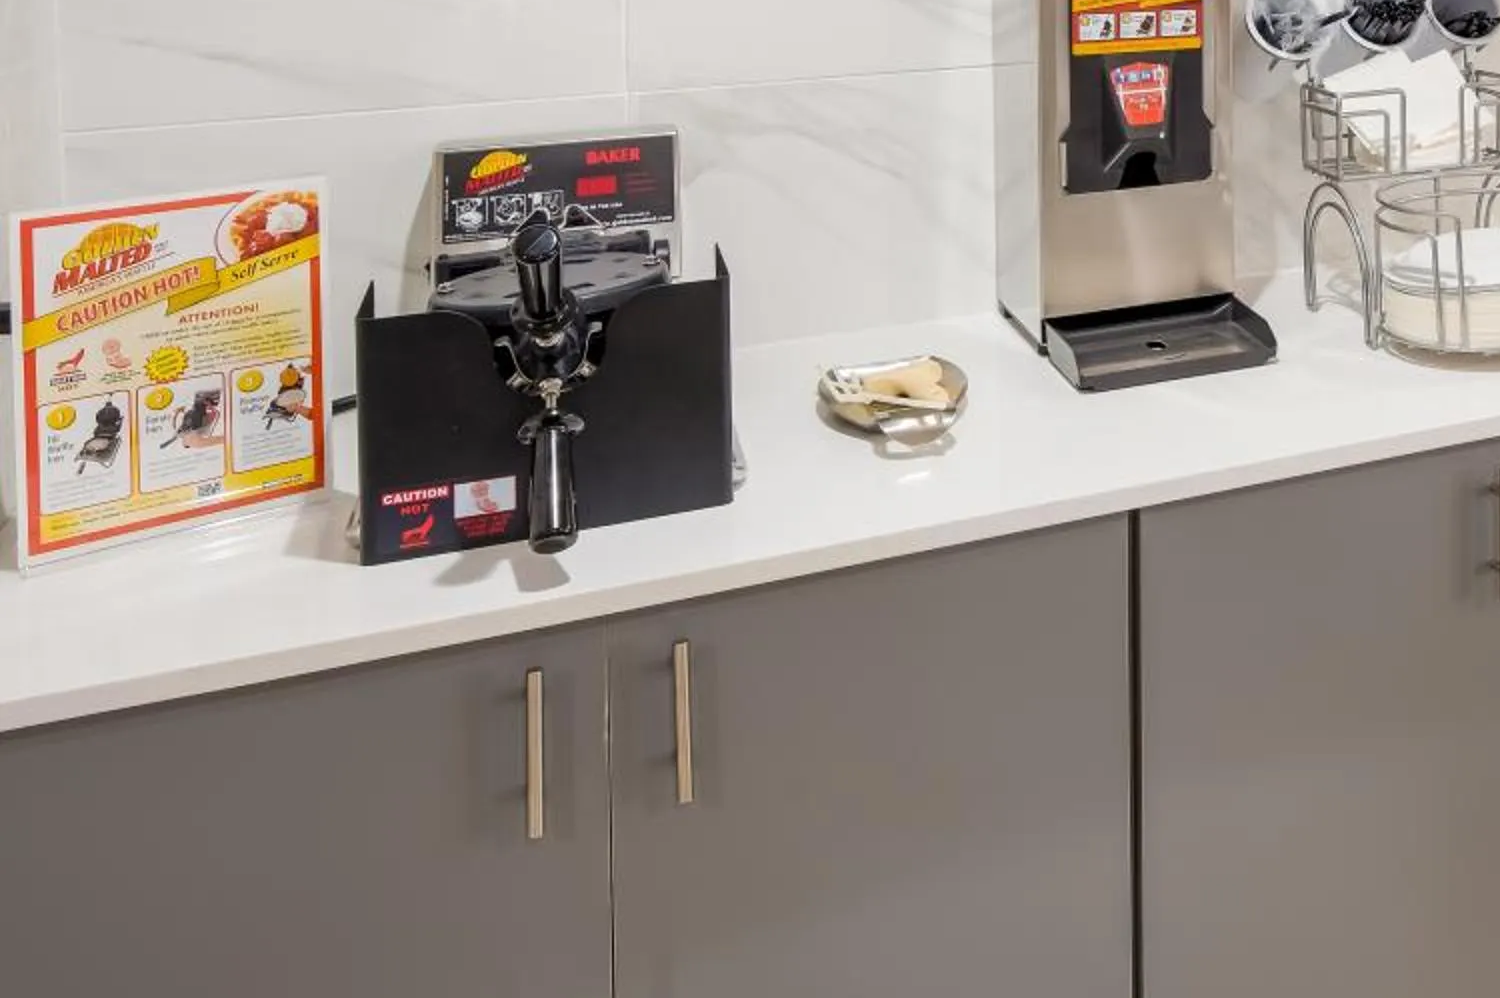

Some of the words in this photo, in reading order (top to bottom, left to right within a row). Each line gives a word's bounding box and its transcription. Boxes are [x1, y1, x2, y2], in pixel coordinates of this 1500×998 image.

[585, 146, 641, 165] BAKER
[52, 241, 152, 294] MALTED
[230, 262, 258, 284] Self
[259, 250, 299, 270] Serve
[56, 286, 148, 331] CAUTION
[153, 264, 200, 296] HOT!
[179, 302, 260, 324] ATTENTION!
[382, 485, 450, 507] CAUTION
[400, 503, 431, 516] HOT
